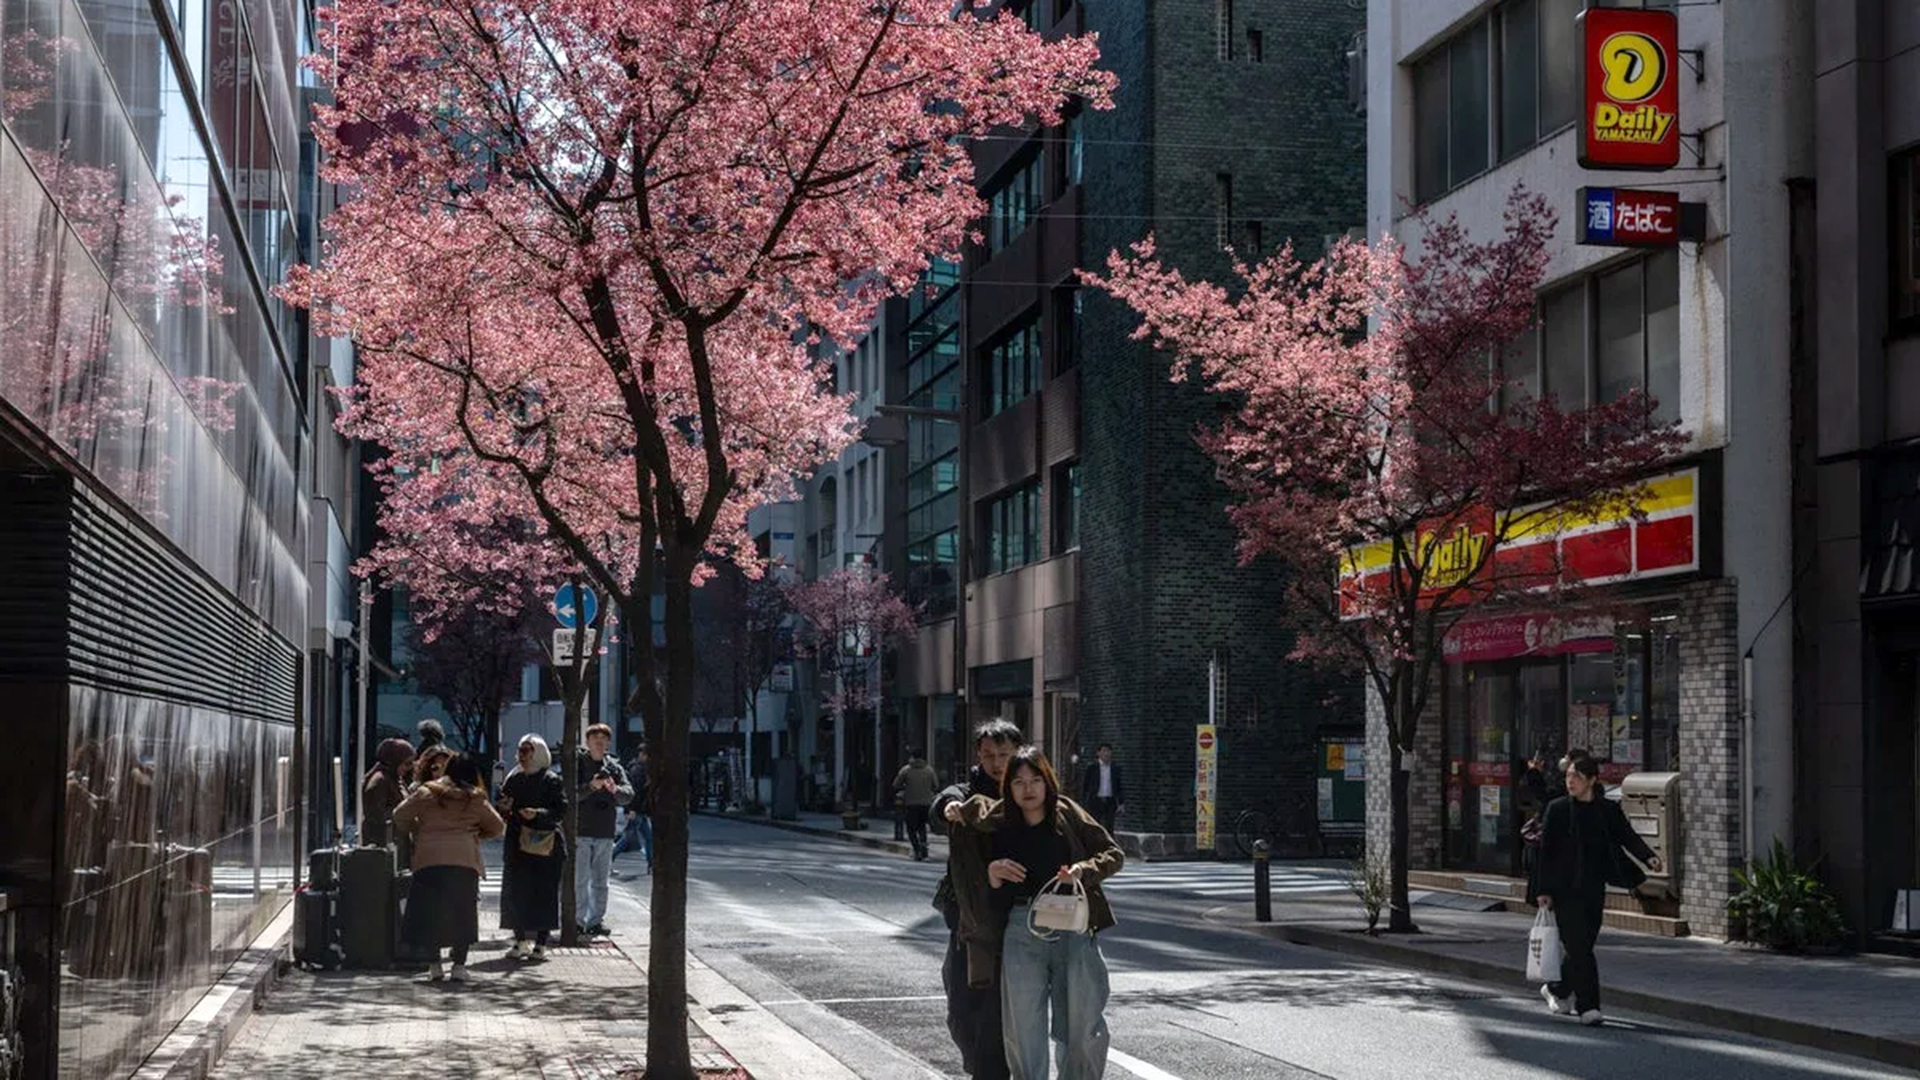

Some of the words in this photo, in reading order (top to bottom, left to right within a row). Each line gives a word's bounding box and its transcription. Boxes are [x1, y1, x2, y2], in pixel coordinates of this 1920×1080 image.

[1595, 103, 1675, 143] Daily
[1595, 128, 1653, 142] YAMAZAKI
[1588, 200, 1611, 230] 酒
[1616, 202, 1673, 233] たばこ
